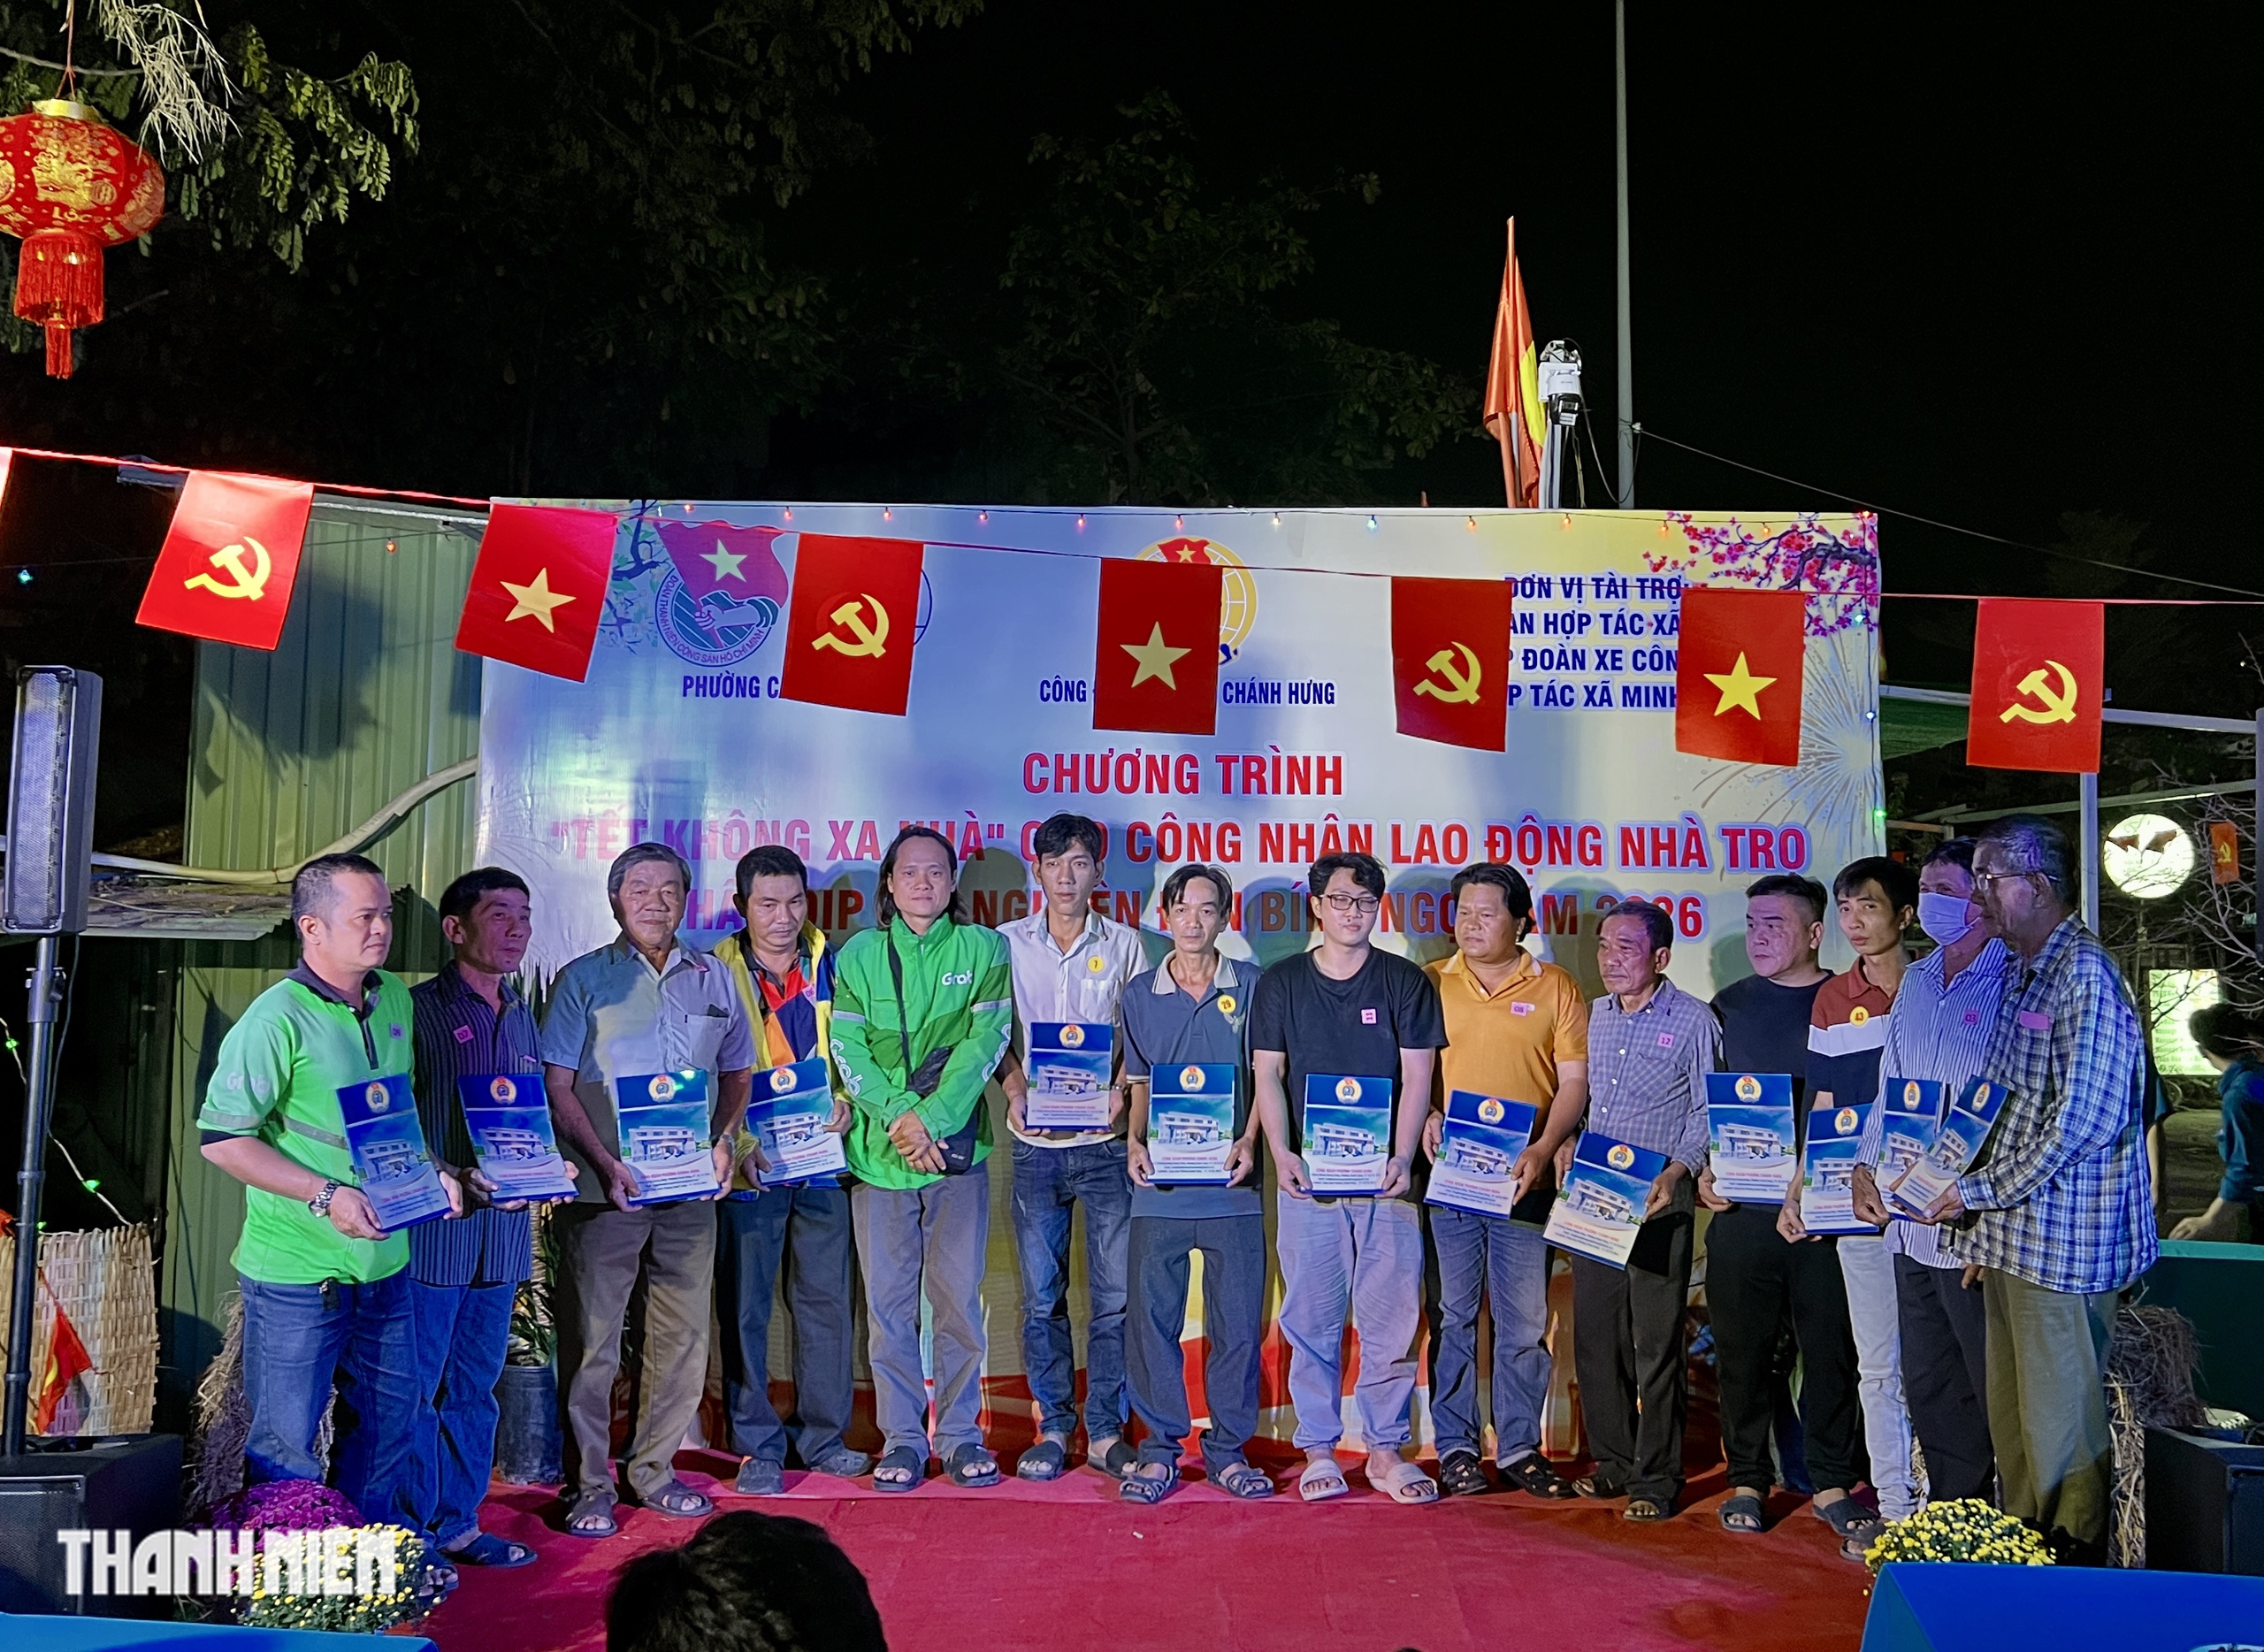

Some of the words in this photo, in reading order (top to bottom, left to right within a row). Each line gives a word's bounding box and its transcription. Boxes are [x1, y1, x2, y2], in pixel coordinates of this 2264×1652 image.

[1560, 577, 1583, 604] VỊ
[1591, 572, 1627, 599] TÀI
[1544, 610, 1592, 639] HỢP
[1599, 608, 1645, 636] TÁC
[1652, 608, 1679, 636] XÃ
[1521, 643, 1586, 671] ĐOÀN
[1595, 649, 1624, 671] XE
[1633, 644, 1678, 672] CÔN
[683, 670, 761, 699] PHƯỜNG
[1040, 674, 1087, 703] CÔNG
[1223, 677, 1281, 704] CHÁNH
[1289, 679, 1335, 705] HƯNG
[1530, 679, 1575, 707] TÁC
[1583, 680, 1613, 707] XÃ
[1022, 747, 1200, 795] CHƯƠNG
[1215, 745, 1342, 795] TRÌNH
[664, 808, 810, 861] KHÔNG
[826, 820, 882, 860] XA
[1125, 811, 1242, 864] CÔNG
[1258, 813, 1373, 863] NHÂN
[1391, 823, 1469, 865] LAO
[1483, 814, 1603, 876] ĐỘNG
[1620, 816, 1709, 868] NHÀ
[1661, 1036, 1671, 1045] 12
